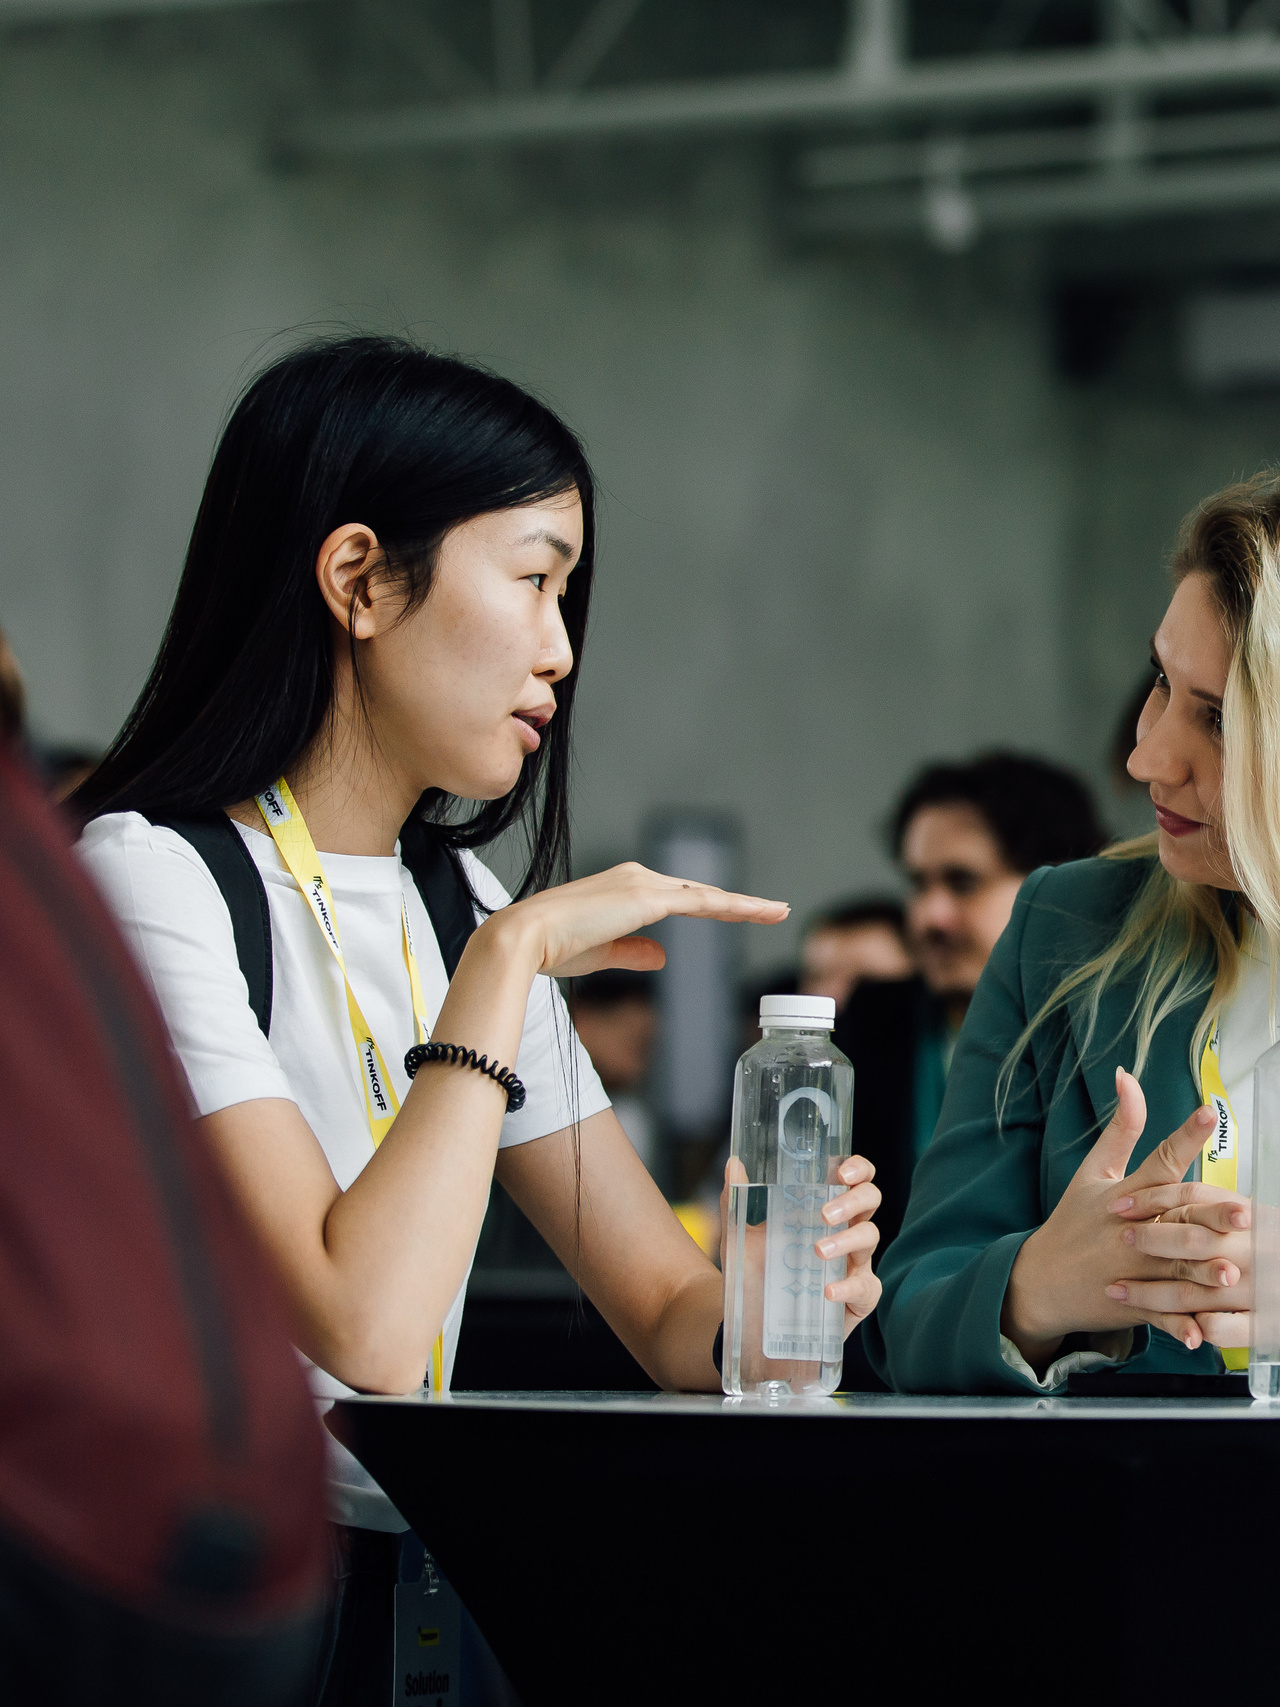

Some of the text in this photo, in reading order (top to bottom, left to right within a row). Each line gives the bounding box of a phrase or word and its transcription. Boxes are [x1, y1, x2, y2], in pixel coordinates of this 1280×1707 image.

[312, 888, 339, 949] TINKOFF
[365, 1048, 387, 1111] TINKOFF
[1215, 1098, 1229, 1152] TINKOFF
[404, 1669, 450, 1697] Solution
